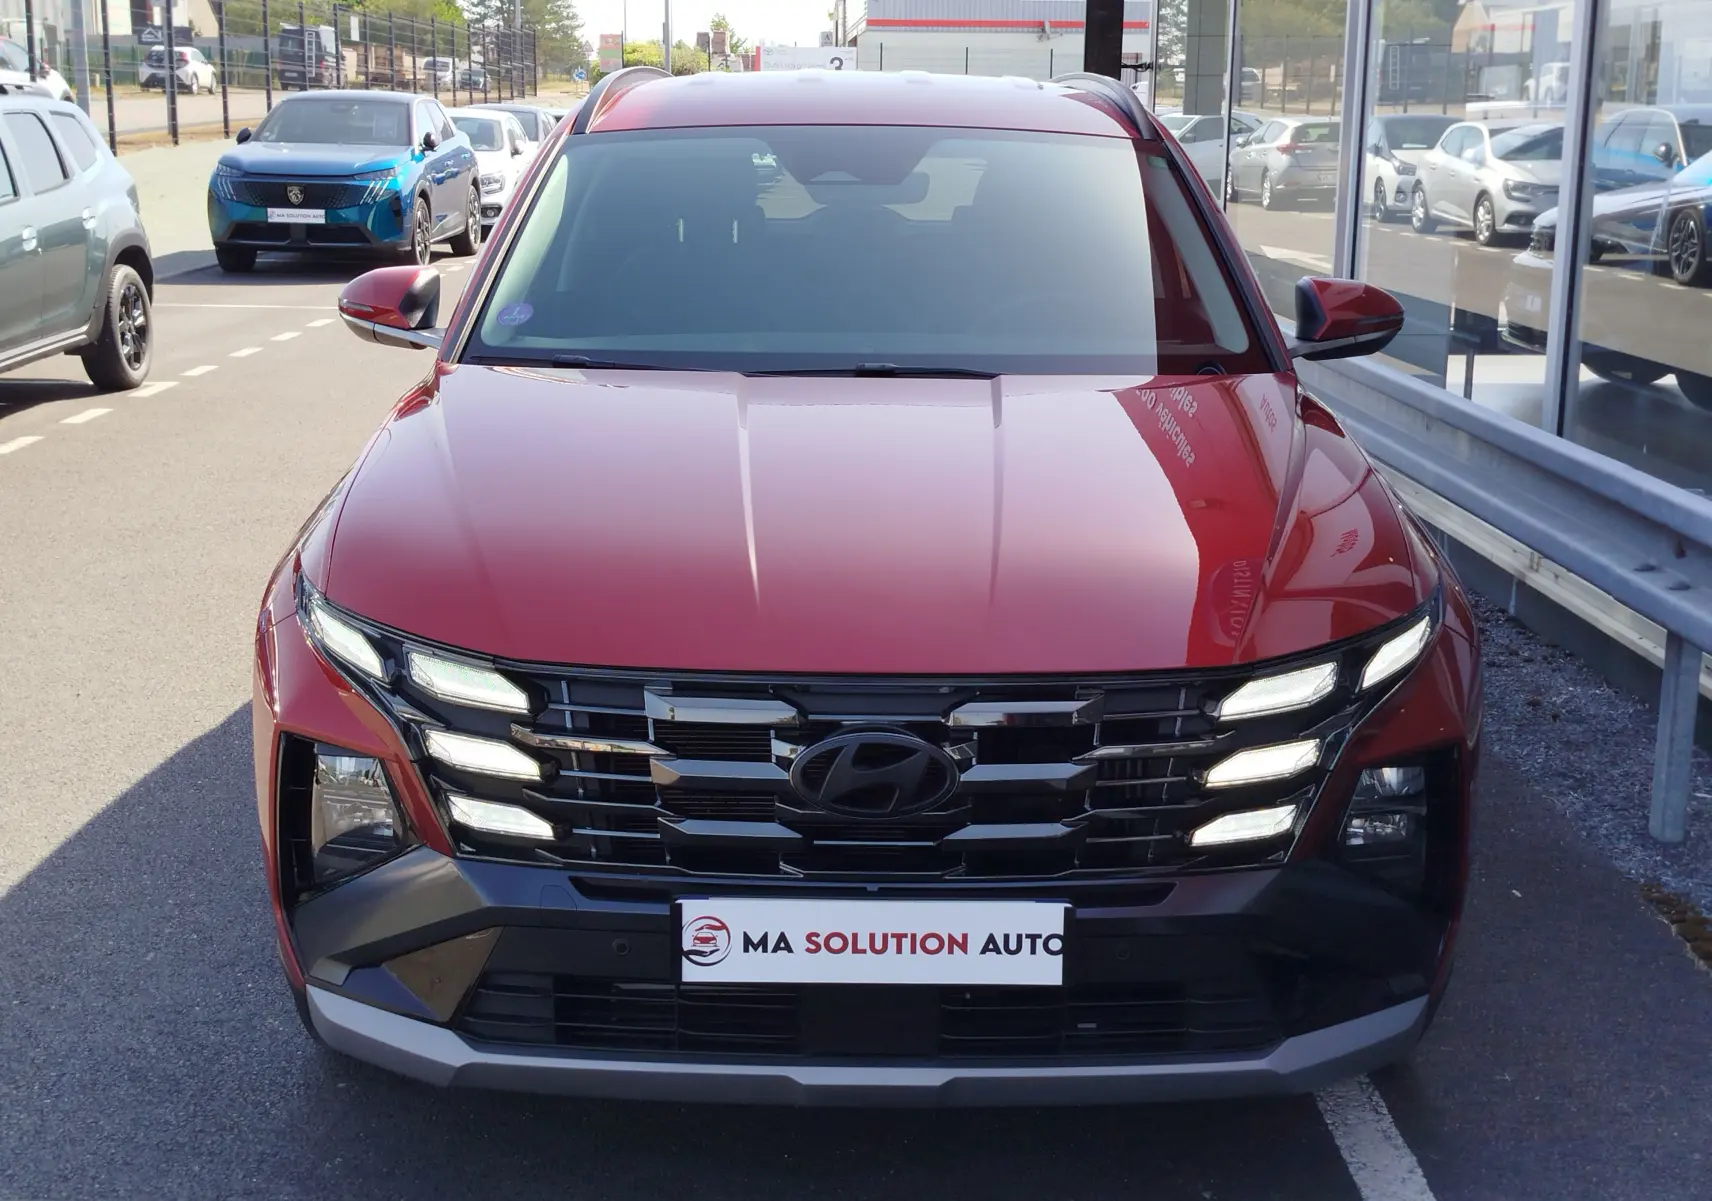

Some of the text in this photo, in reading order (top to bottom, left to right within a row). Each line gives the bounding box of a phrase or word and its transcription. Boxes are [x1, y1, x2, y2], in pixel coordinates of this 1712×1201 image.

[742, 930, 1065, 956] MA SOLUTION AUTO
